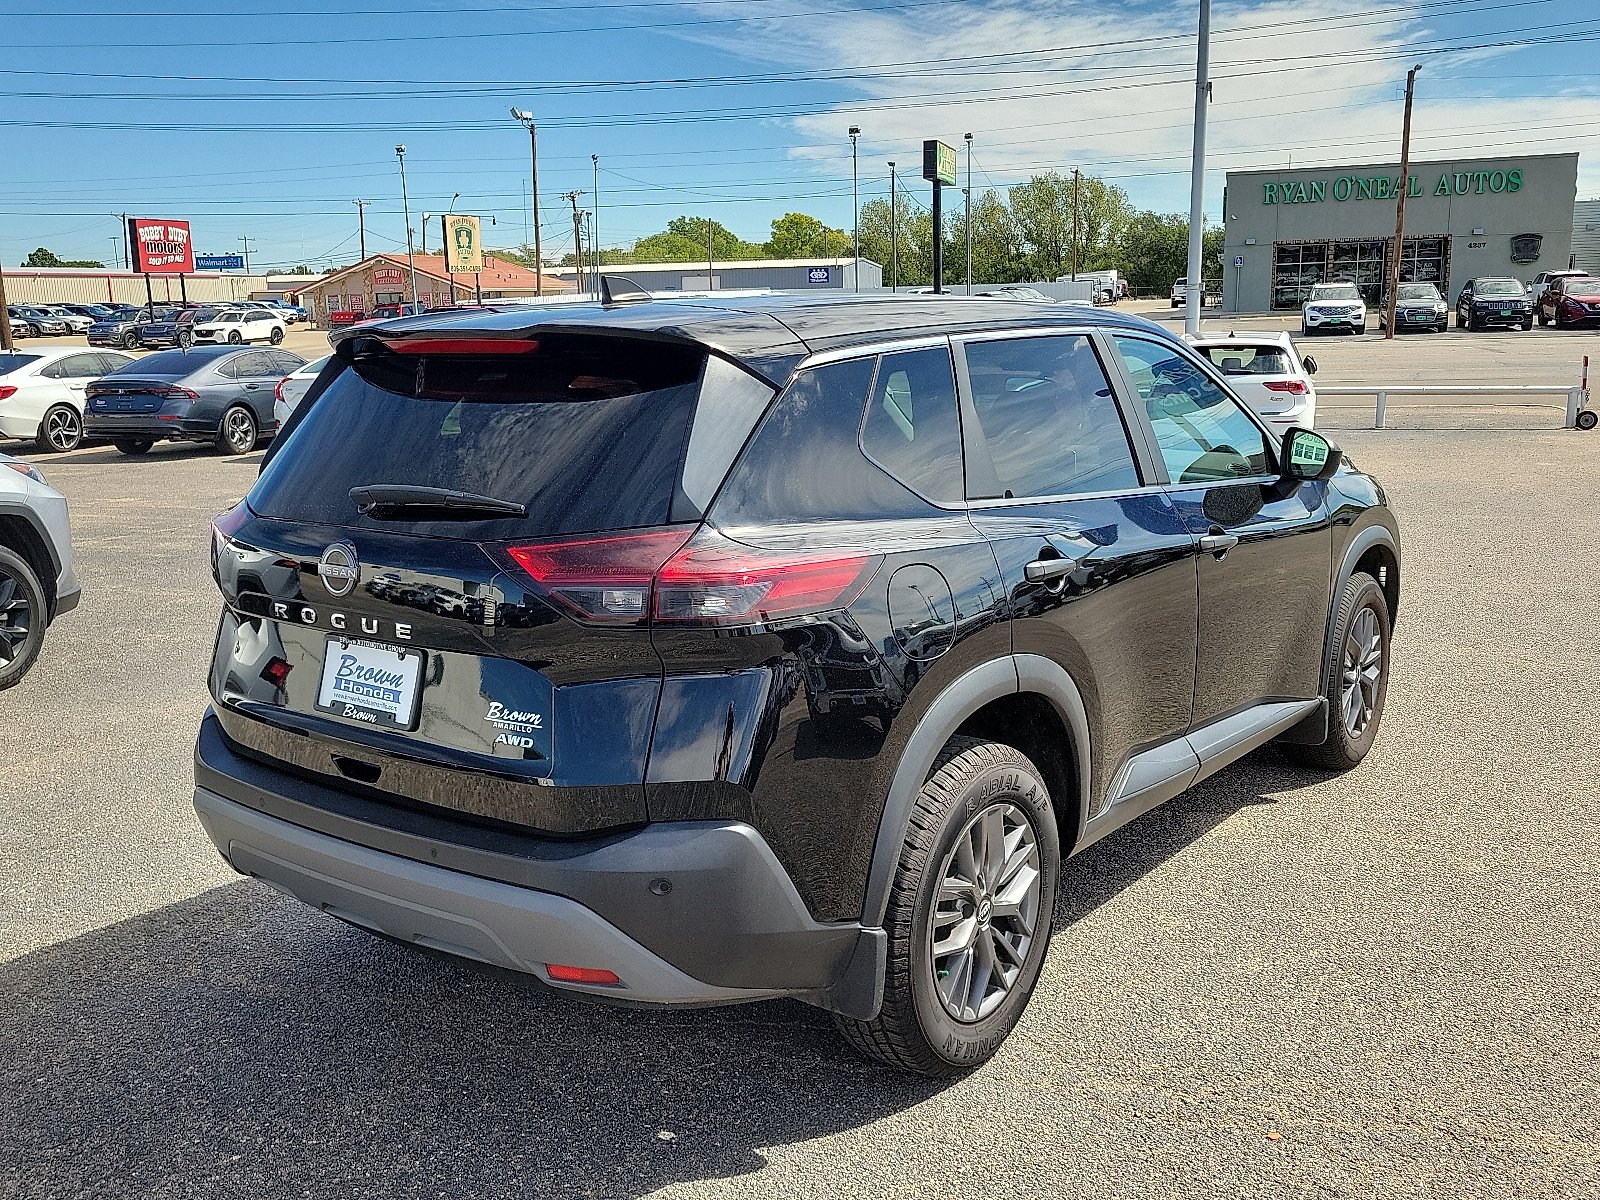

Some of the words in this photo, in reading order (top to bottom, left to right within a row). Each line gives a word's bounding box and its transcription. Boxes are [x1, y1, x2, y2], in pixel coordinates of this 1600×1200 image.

[1263, 181, 1328, 205] RYAN
[1433, 168, 1523, 196] AUTOS
[139, 225, 164, 243] BOBBY
[167, 225, 188, 245] DUBY
[146, 240, 185, 255] motors
[198, 259, 227, 267] Walmart
[273, 602, 413, 640] ROGUE
[387, 645, 406, 655] GROUP
[336, 654, 404, 688] Brown
[340, 679, 394, 701] Honda
[342, 703, 377, 723] Brown
[486, 701, 543, 725] Brown
[492, 722, 533, 733] AMARILLO
[494, 733, 534, 748] AWD
[966, 773, 1021, 819] RADIAL
